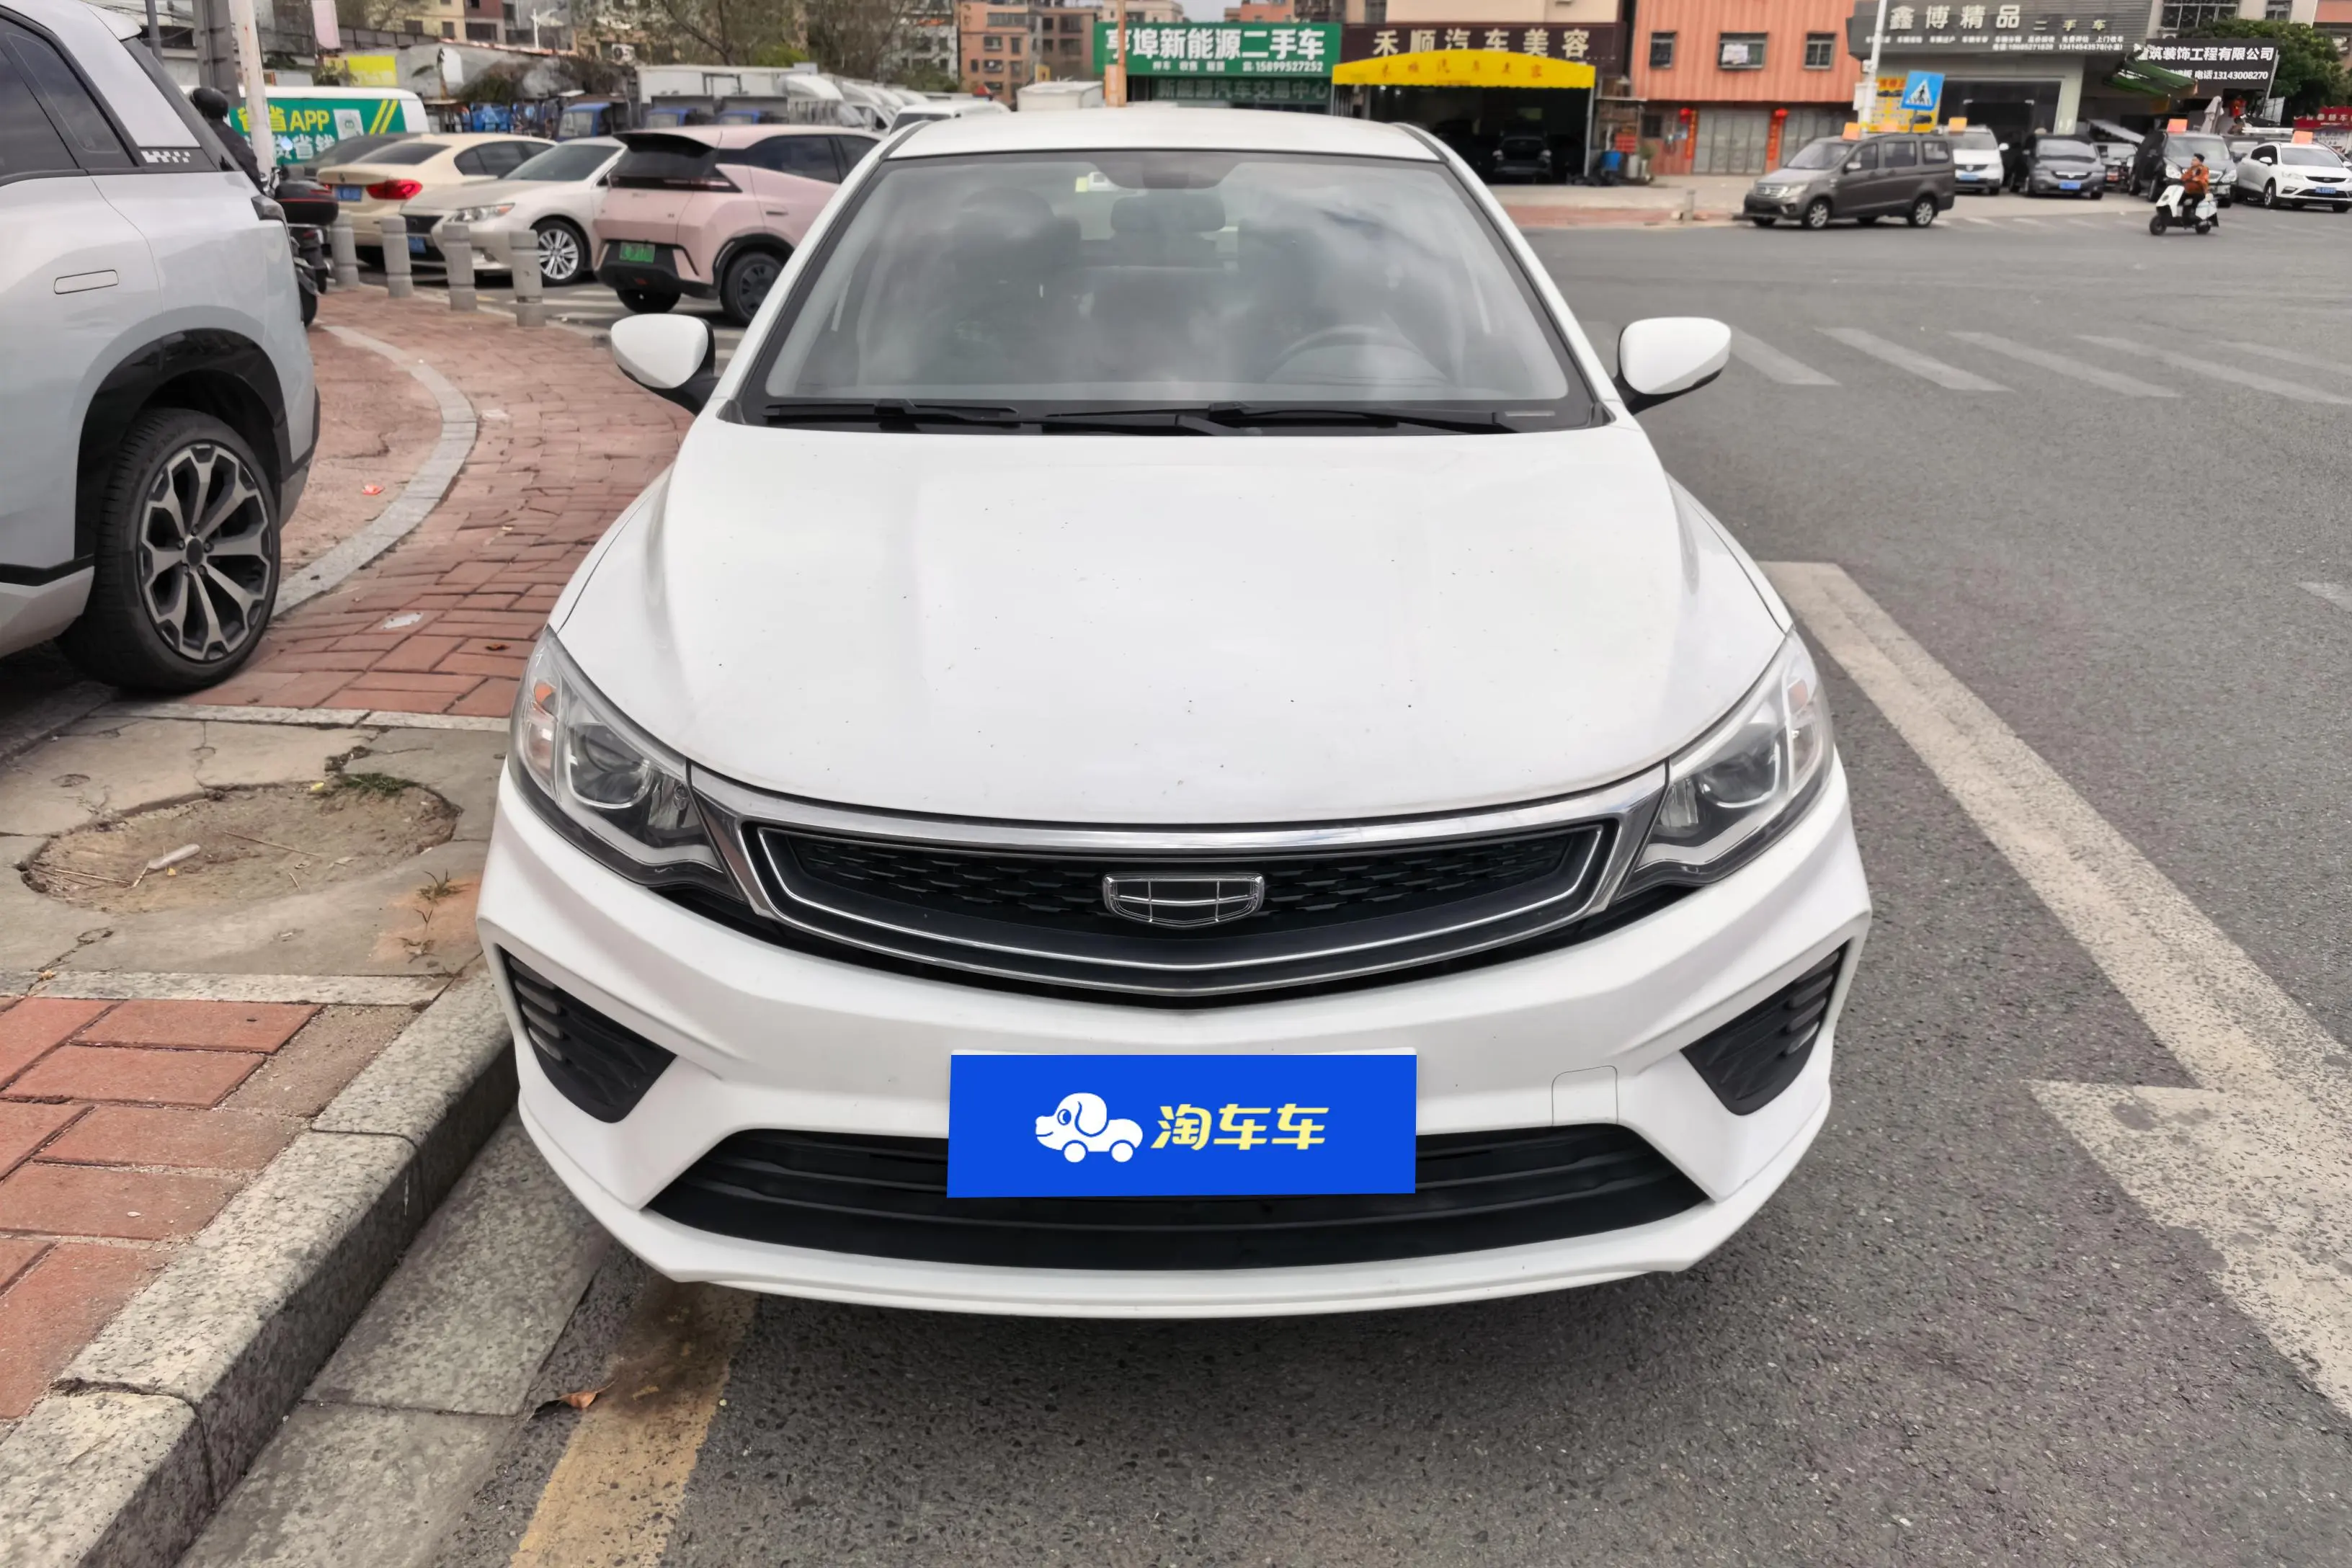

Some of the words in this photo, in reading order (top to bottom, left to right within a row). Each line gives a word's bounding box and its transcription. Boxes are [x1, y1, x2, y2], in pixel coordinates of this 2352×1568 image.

[1889, 5, 2021, 30] 鑫博精品
[2033, 19, 2106, 31] 二手车
[1373, 28, 1590, 58] 禾顺汽车美容
[1157, 78, 1329, 100] 新能源汽车交易中心
